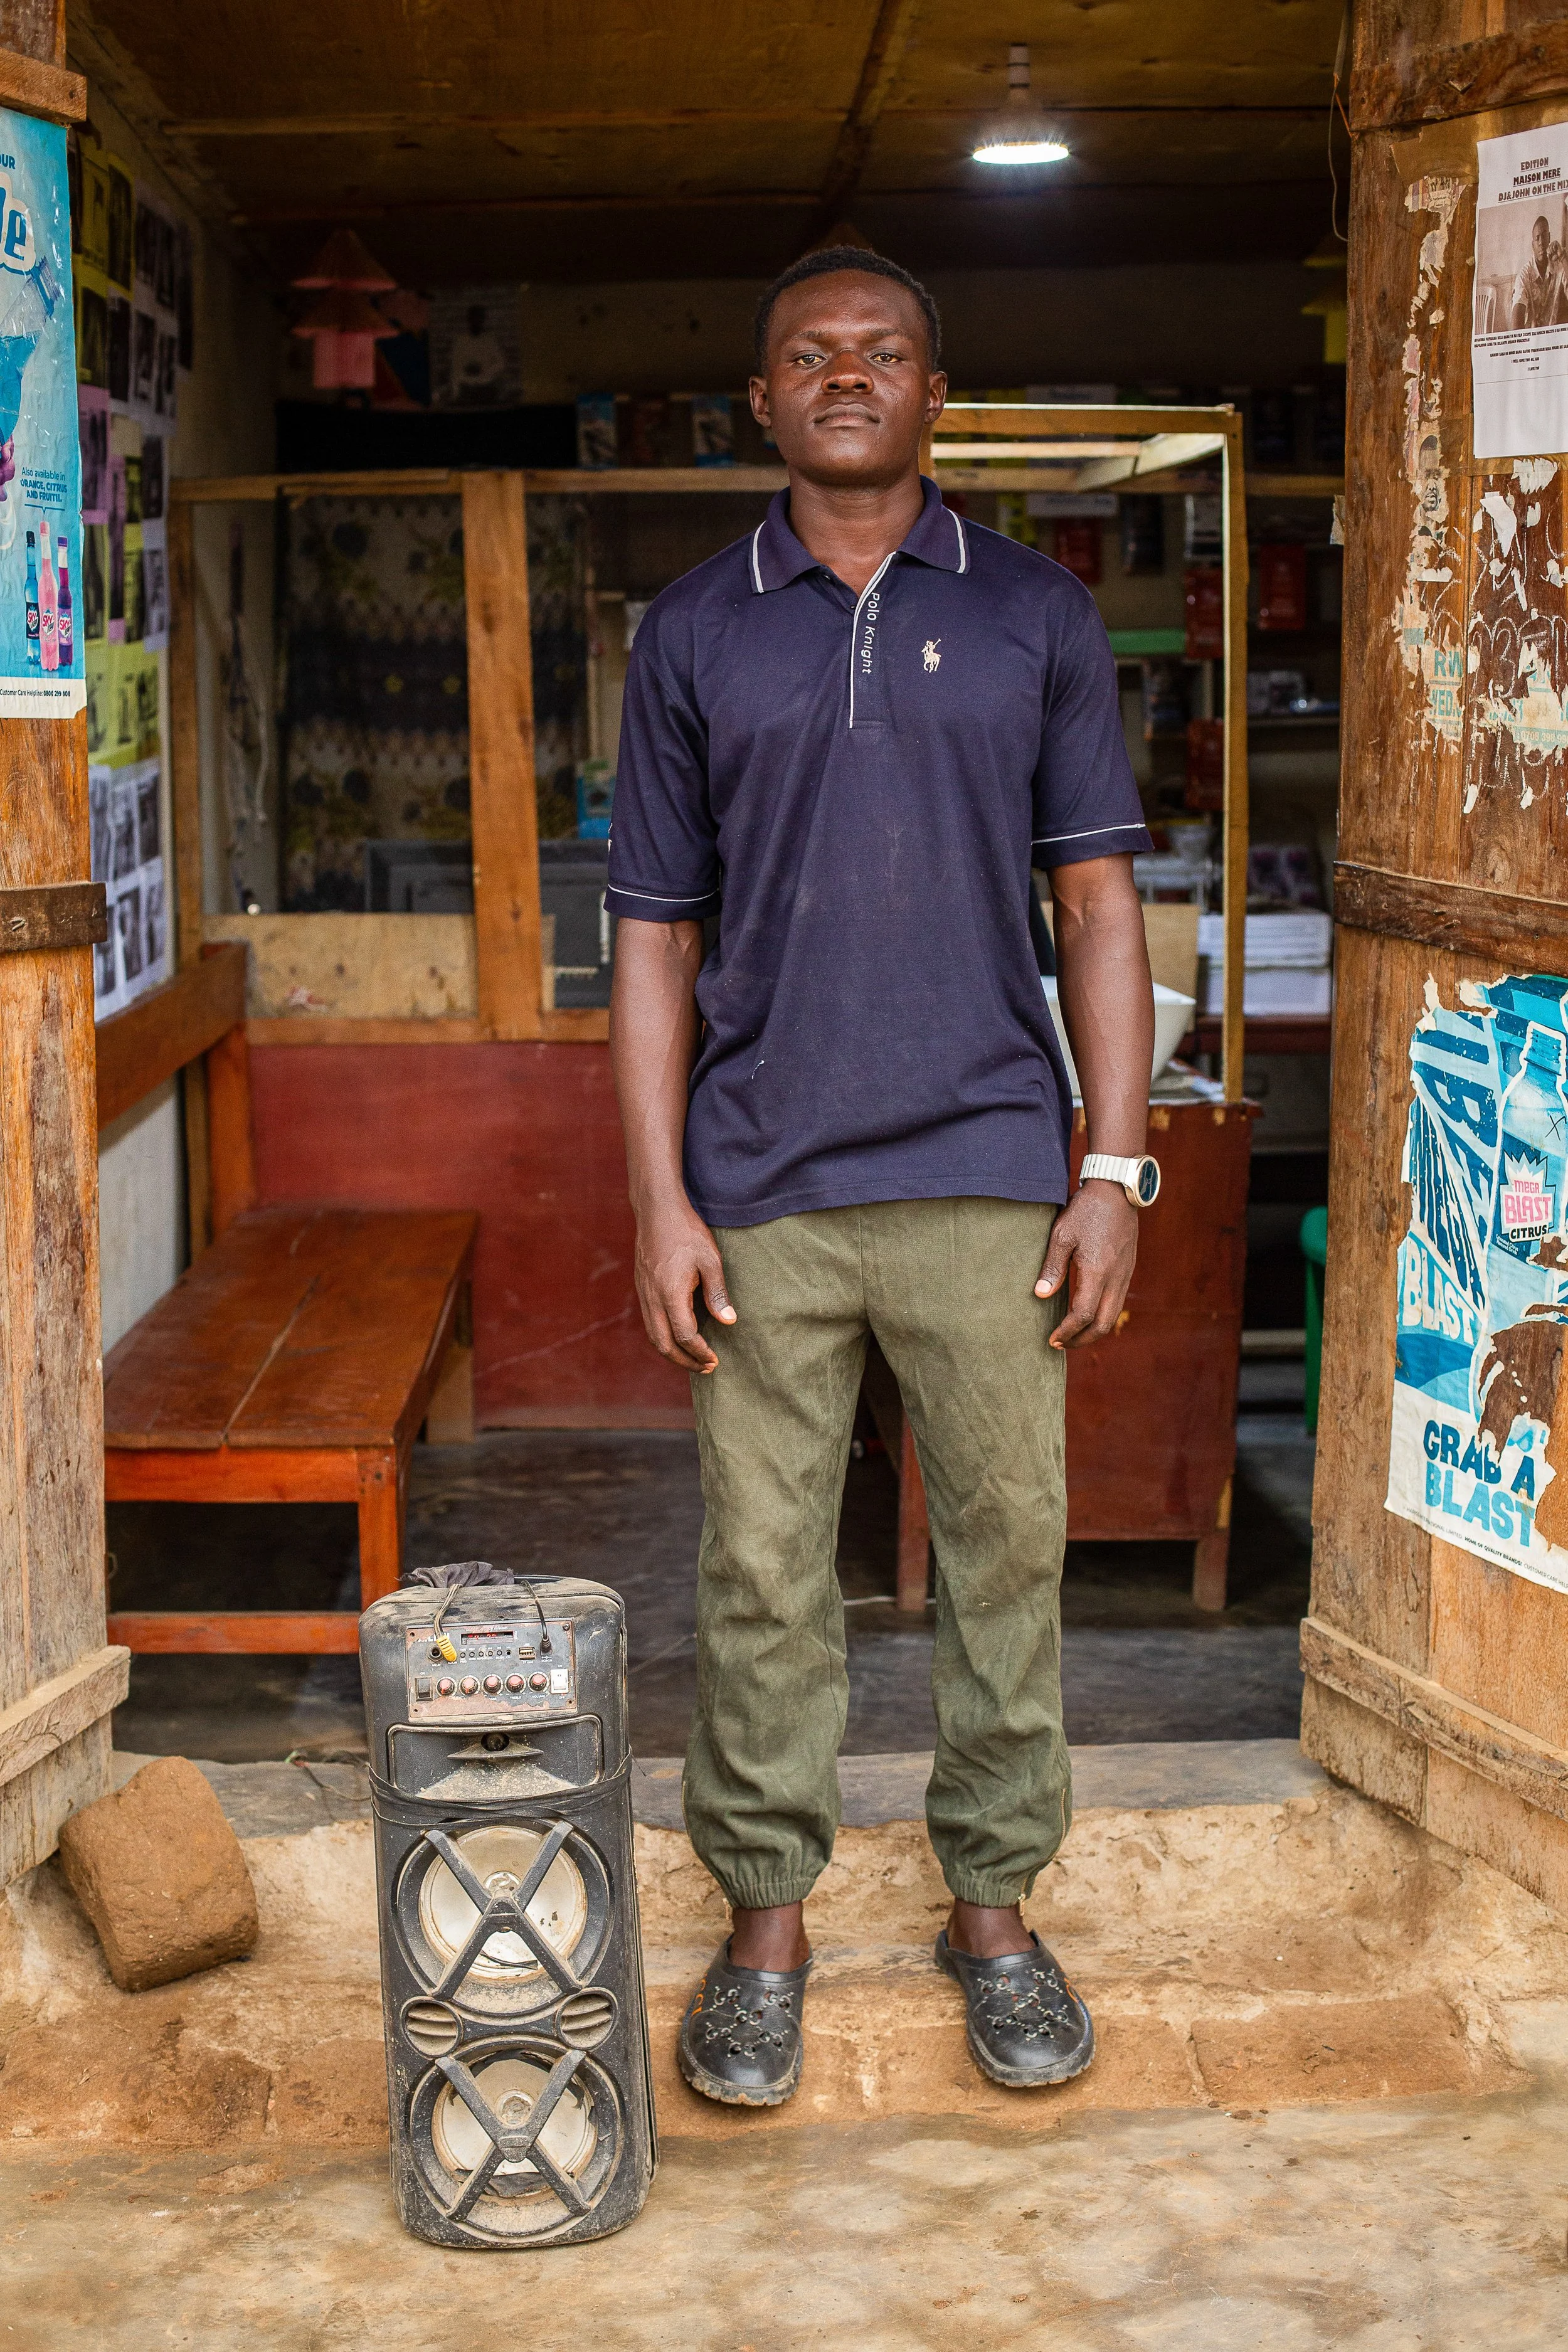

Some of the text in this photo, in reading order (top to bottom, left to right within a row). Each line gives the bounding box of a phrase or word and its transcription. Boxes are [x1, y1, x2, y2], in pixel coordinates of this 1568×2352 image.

[1520, 157, 1549, 171] EDITION
[1513, 167, 1561, 186] MAISON MERE
[1498, 188, 1530, 201] DJ&JOHN
[1532, 186, 1542, 195] ON
[1543, 183, 1555, 193] THE
[22, 467, 65, 481] Also available in
[20, 479, 67, 493] ORANGE, CITRUS
[27, 490, 38, 499] AND
[867, 592, 880, 621] Polo
[1505, 1195, 1551, 1224] BLAST
[1510, 1225, 1547, 1239] CITRUS
[1402, 1237, 1475, 1344] BLAST
[1423, 1419, 1535, 1501] GRAB A
[1425, 1461, 1536, 1547] BLAST
[1465, 1536, 1476, 1545] HOME
[1484, 1545, 1502, 1557] QUALITY
[1523, 1563, 1547, 1577] CUSTOMER
